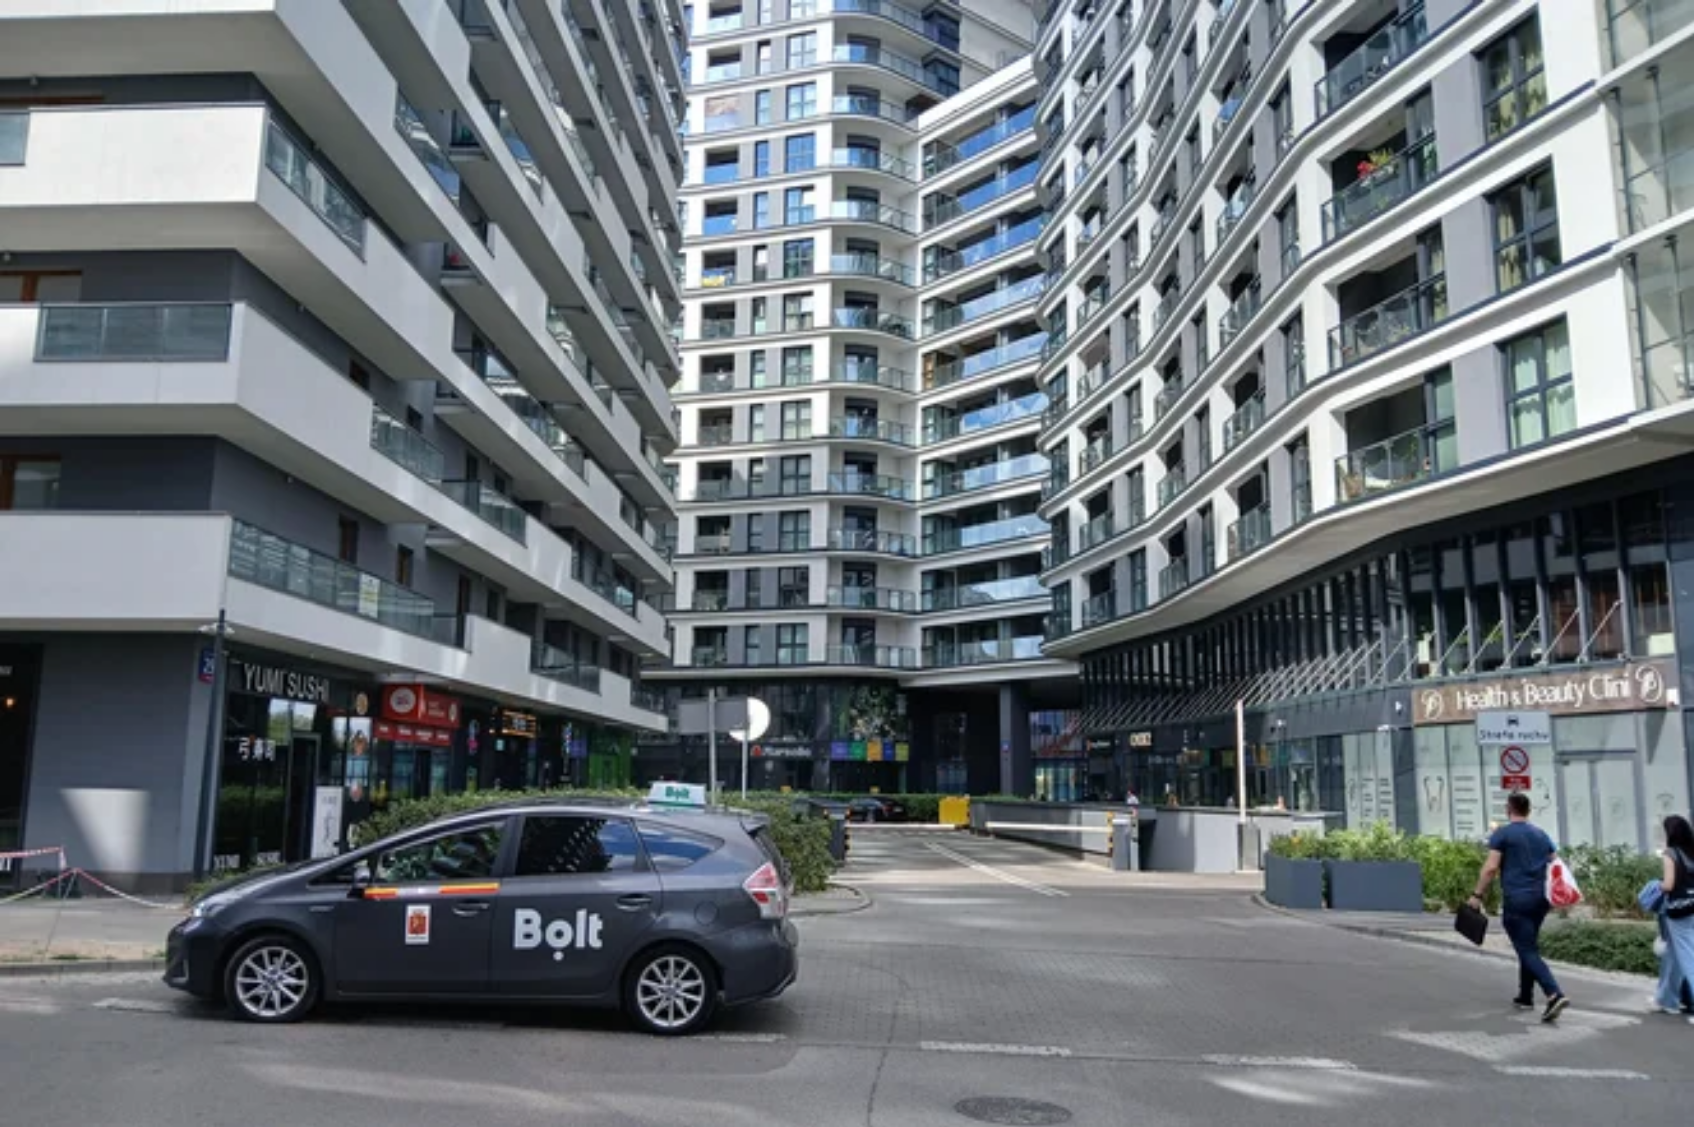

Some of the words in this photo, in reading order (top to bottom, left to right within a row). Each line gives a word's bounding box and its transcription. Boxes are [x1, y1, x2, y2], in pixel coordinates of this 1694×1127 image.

[244, 663, 286, 694] YUMI
[287, 672, 330, 703] SUSHI
[1456, 686, 1509, 711] Health
[1521, 678, 1586, 708] Beauty
[665, 785, 690, 801] Bolt
[514, 907, 604, 962] Bolt
